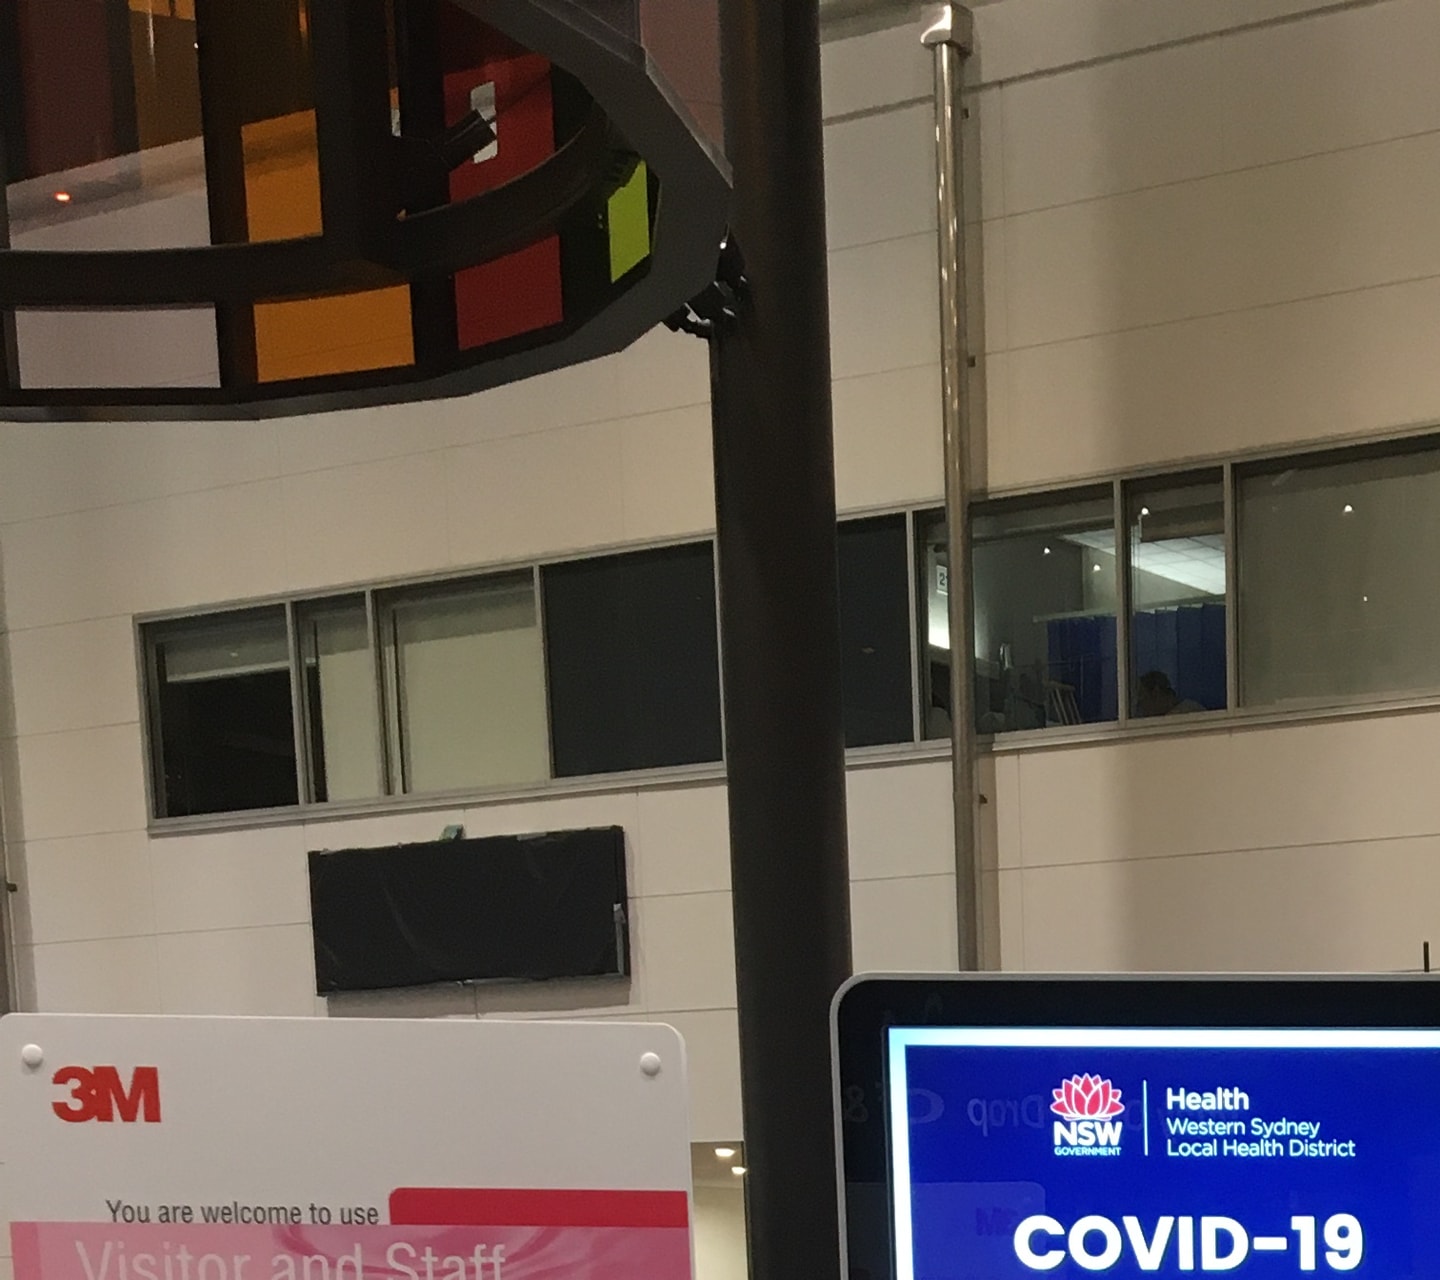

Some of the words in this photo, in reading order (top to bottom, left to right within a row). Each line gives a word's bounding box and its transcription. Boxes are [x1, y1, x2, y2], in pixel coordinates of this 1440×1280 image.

[53, 1066, 161, 1122] 3M
[1167, 1087, 1249, 1110] Health
[1053, 1121, 1122, 1146] NSW
[1167, 1118, 1245, 1135] Western
[1251, 1118, 1320, 1138] Sydney
[1053, 1146, 1121, 1156] GOVERNMENT
[1168, 1139, 1217, 1156] Local
[1224, 1137, 1283, 1156] Health
[1290, 1137, 1355, 1156] District
[106, 1200, 150, 1224] You
[159, 1206, 193, 1224] are
[201, 1202, 301, 1225] welcome
[309, 1203, 331, 1225] to
[341, 1207, 379, 1226] use
[1014, 1214, 1362, 1270] COVID-19
